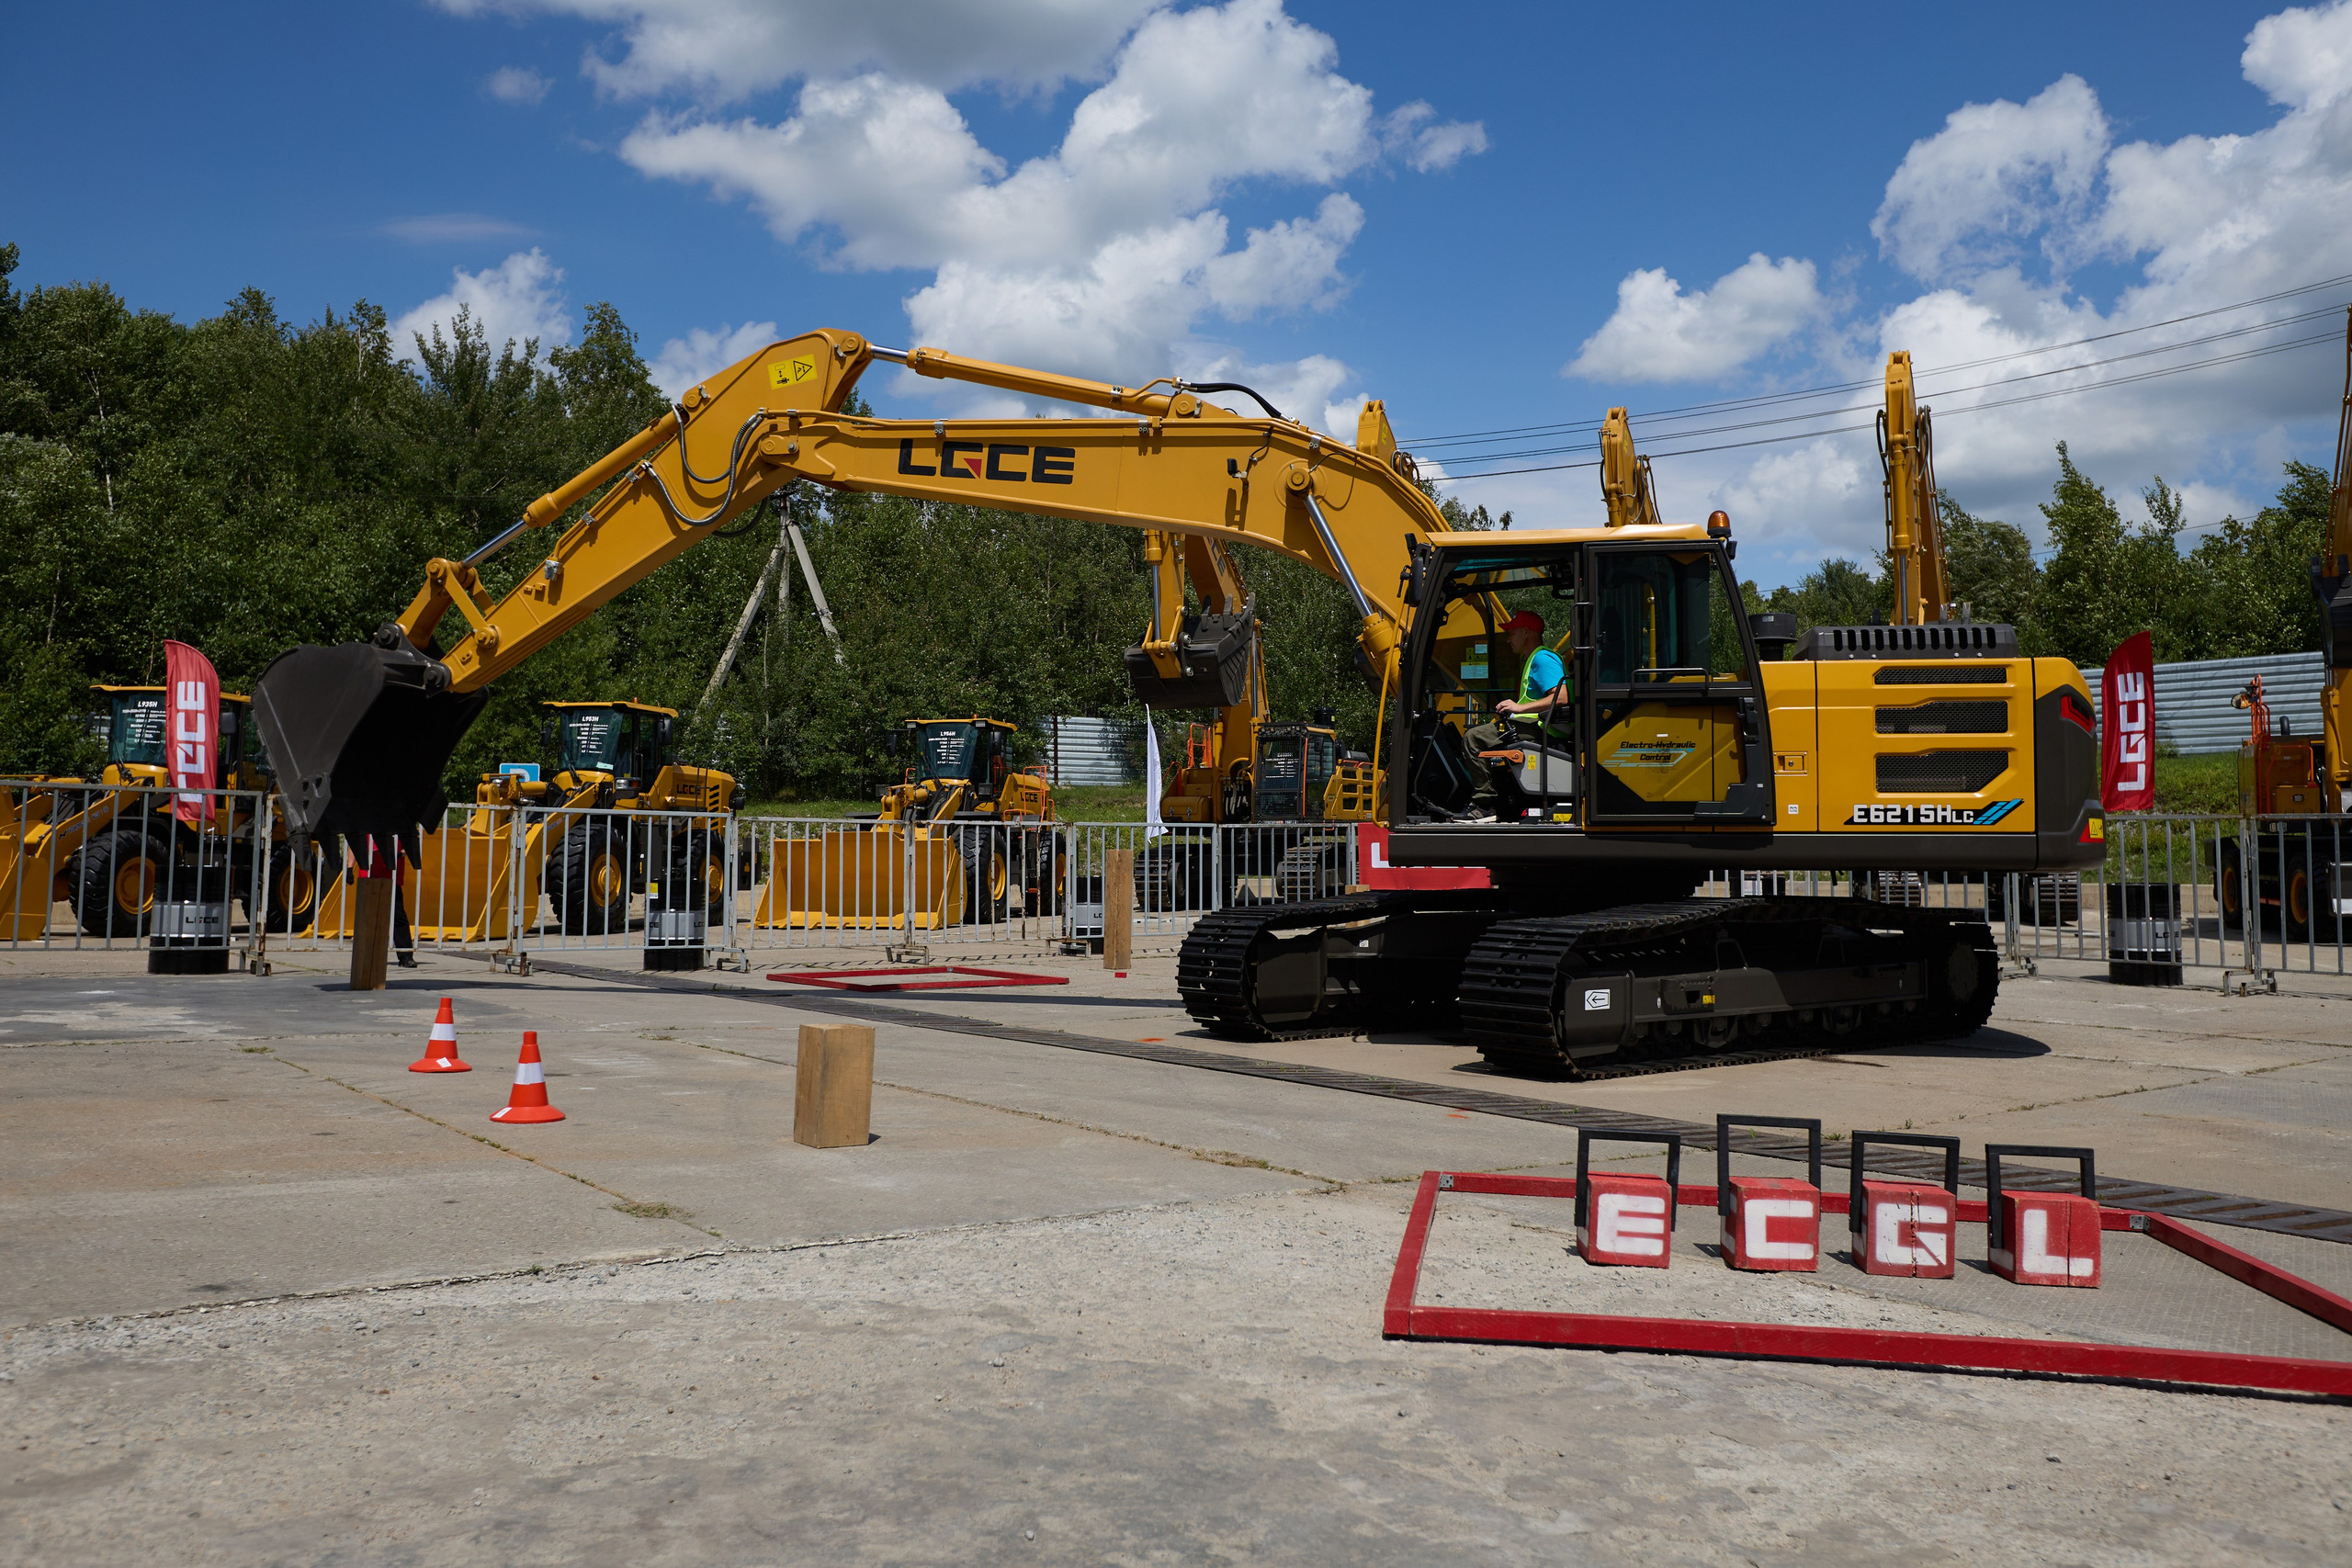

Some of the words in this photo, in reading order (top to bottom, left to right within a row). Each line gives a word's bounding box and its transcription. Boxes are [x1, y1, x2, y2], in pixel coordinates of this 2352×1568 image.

[898, 438, 1076, 484] LGCE
[176, 682, 205, 803] LGCE
[2117, 671, 2146, 792] LGCE
[676, 784, 701, 795] LGCE
[1020, 792, 1038, 803] LGCE
[1596, 1193, 1666, 1256] E
[1746, 1199, 1814, 1259] C
[1875, 1202, 1947, 1266] G
[2022, 1209, 2094, 1276] L
